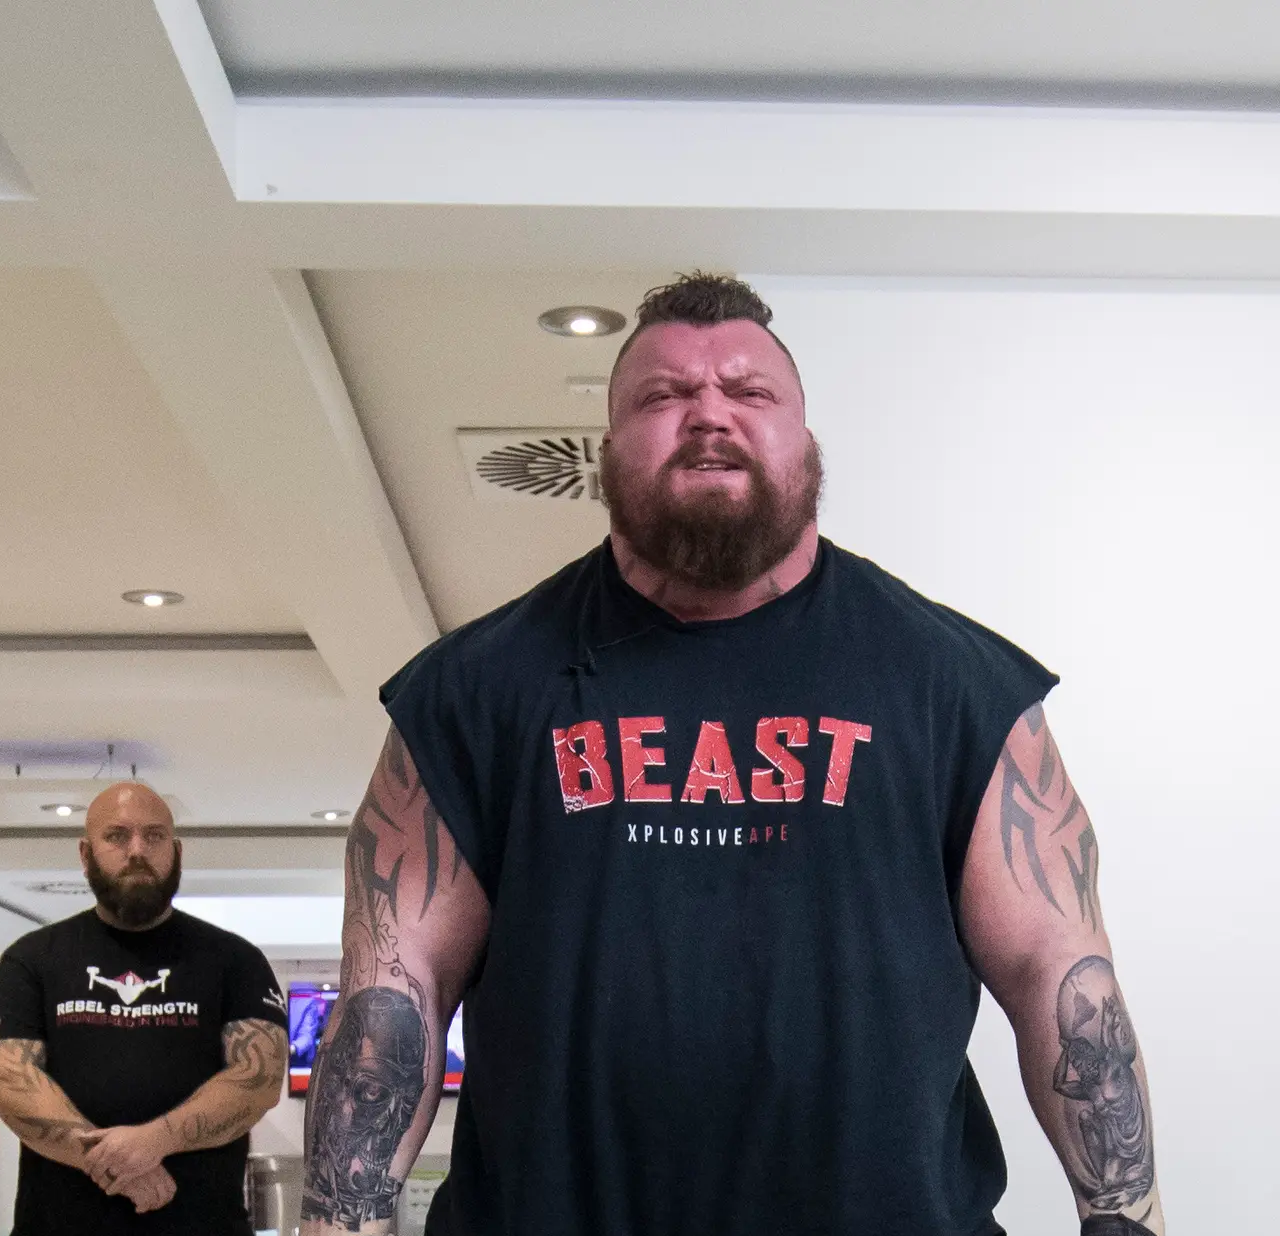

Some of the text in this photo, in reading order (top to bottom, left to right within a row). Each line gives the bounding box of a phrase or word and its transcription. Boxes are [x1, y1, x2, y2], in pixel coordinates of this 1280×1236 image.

[553, 716, 872, 814] BEAST
[627, 823, 789, 846] XPLOSIVEAPE
[56, 1000, 198, 1018] REBEL STRENGTH
